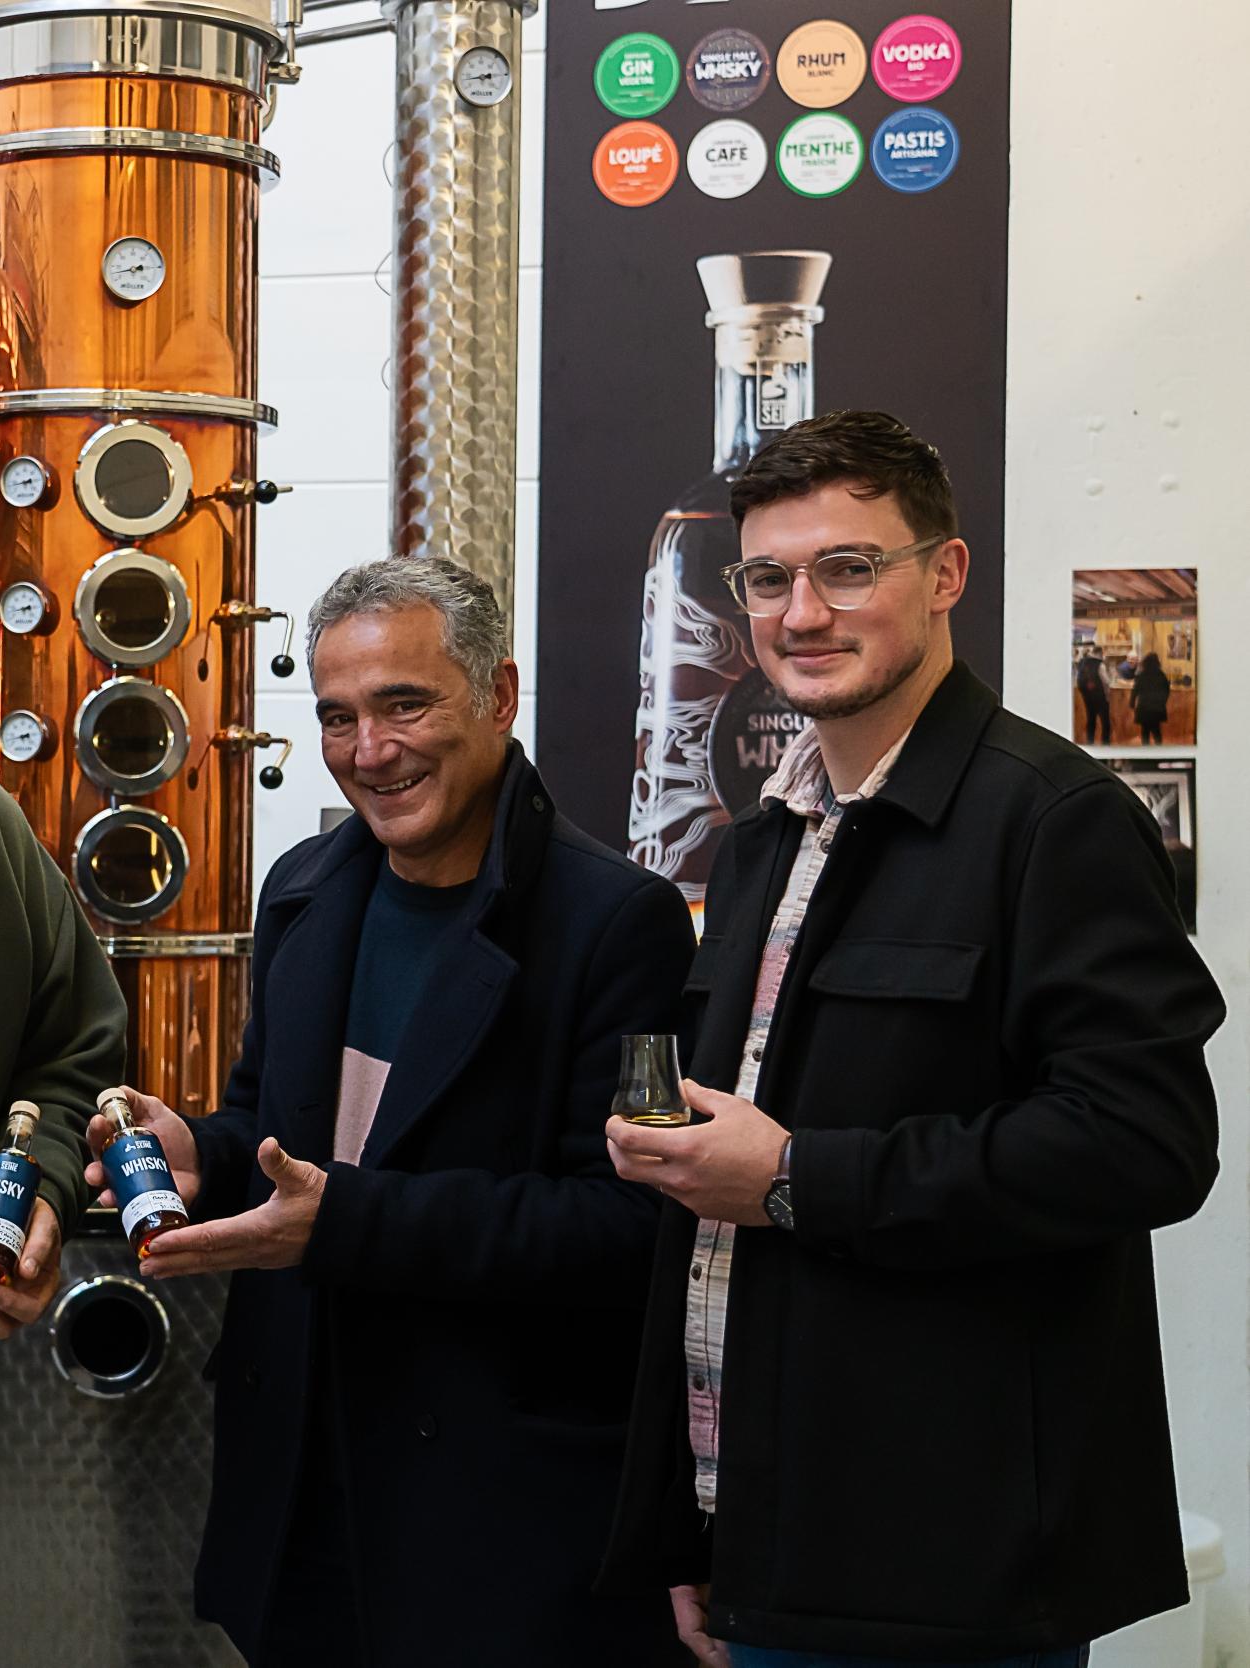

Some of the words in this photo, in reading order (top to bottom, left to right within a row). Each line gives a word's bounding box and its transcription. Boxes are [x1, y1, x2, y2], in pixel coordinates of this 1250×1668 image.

[797, 52, 846, 68] RHUM
[882, 42, 951, 63] VODKA
[621, 60, 654, 76] GIN
[694, 60, 763, 80] WHISKY
[786, 141, 855, 158] MENTHE
[884, 130, 947, 151] PASTIS
[609, 142, 663, 165] LOUPÉ
[121, 1156, 168, 1177] WHISKY
